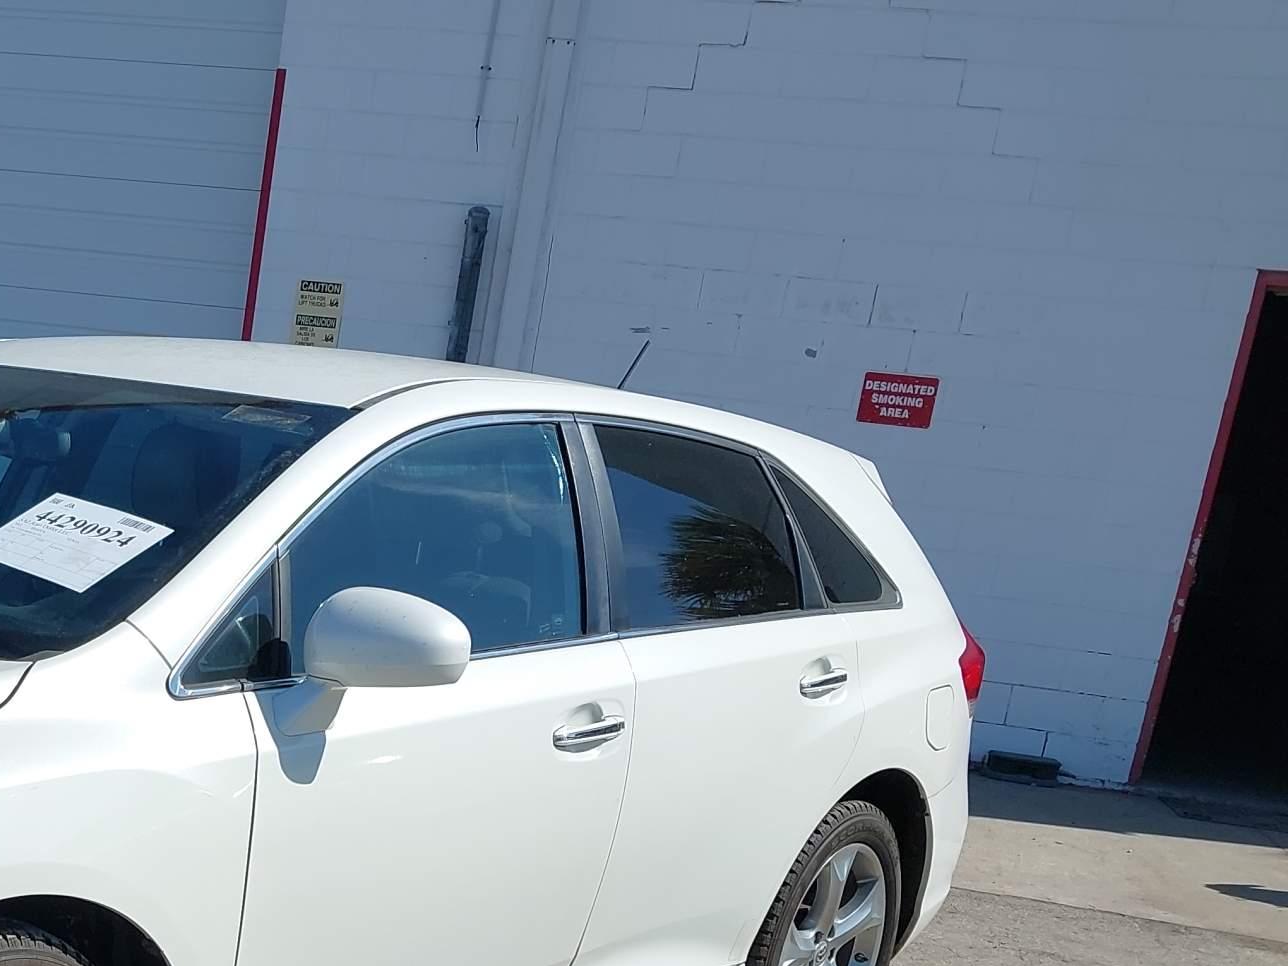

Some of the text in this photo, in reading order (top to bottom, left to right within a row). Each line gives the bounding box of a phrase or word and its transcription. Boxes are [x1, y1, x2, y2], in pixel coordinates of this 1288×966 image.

[302, 282, 340, 293] CAUTION
[297, 315, 336, 328] PRECAUCION
[865, 380, 935, 396] DESIGNATED
[872, 393, 923, 408] SMOKING
[880, 407, 909, 418] AREA
[35, 510, 137, 548] 44290924
